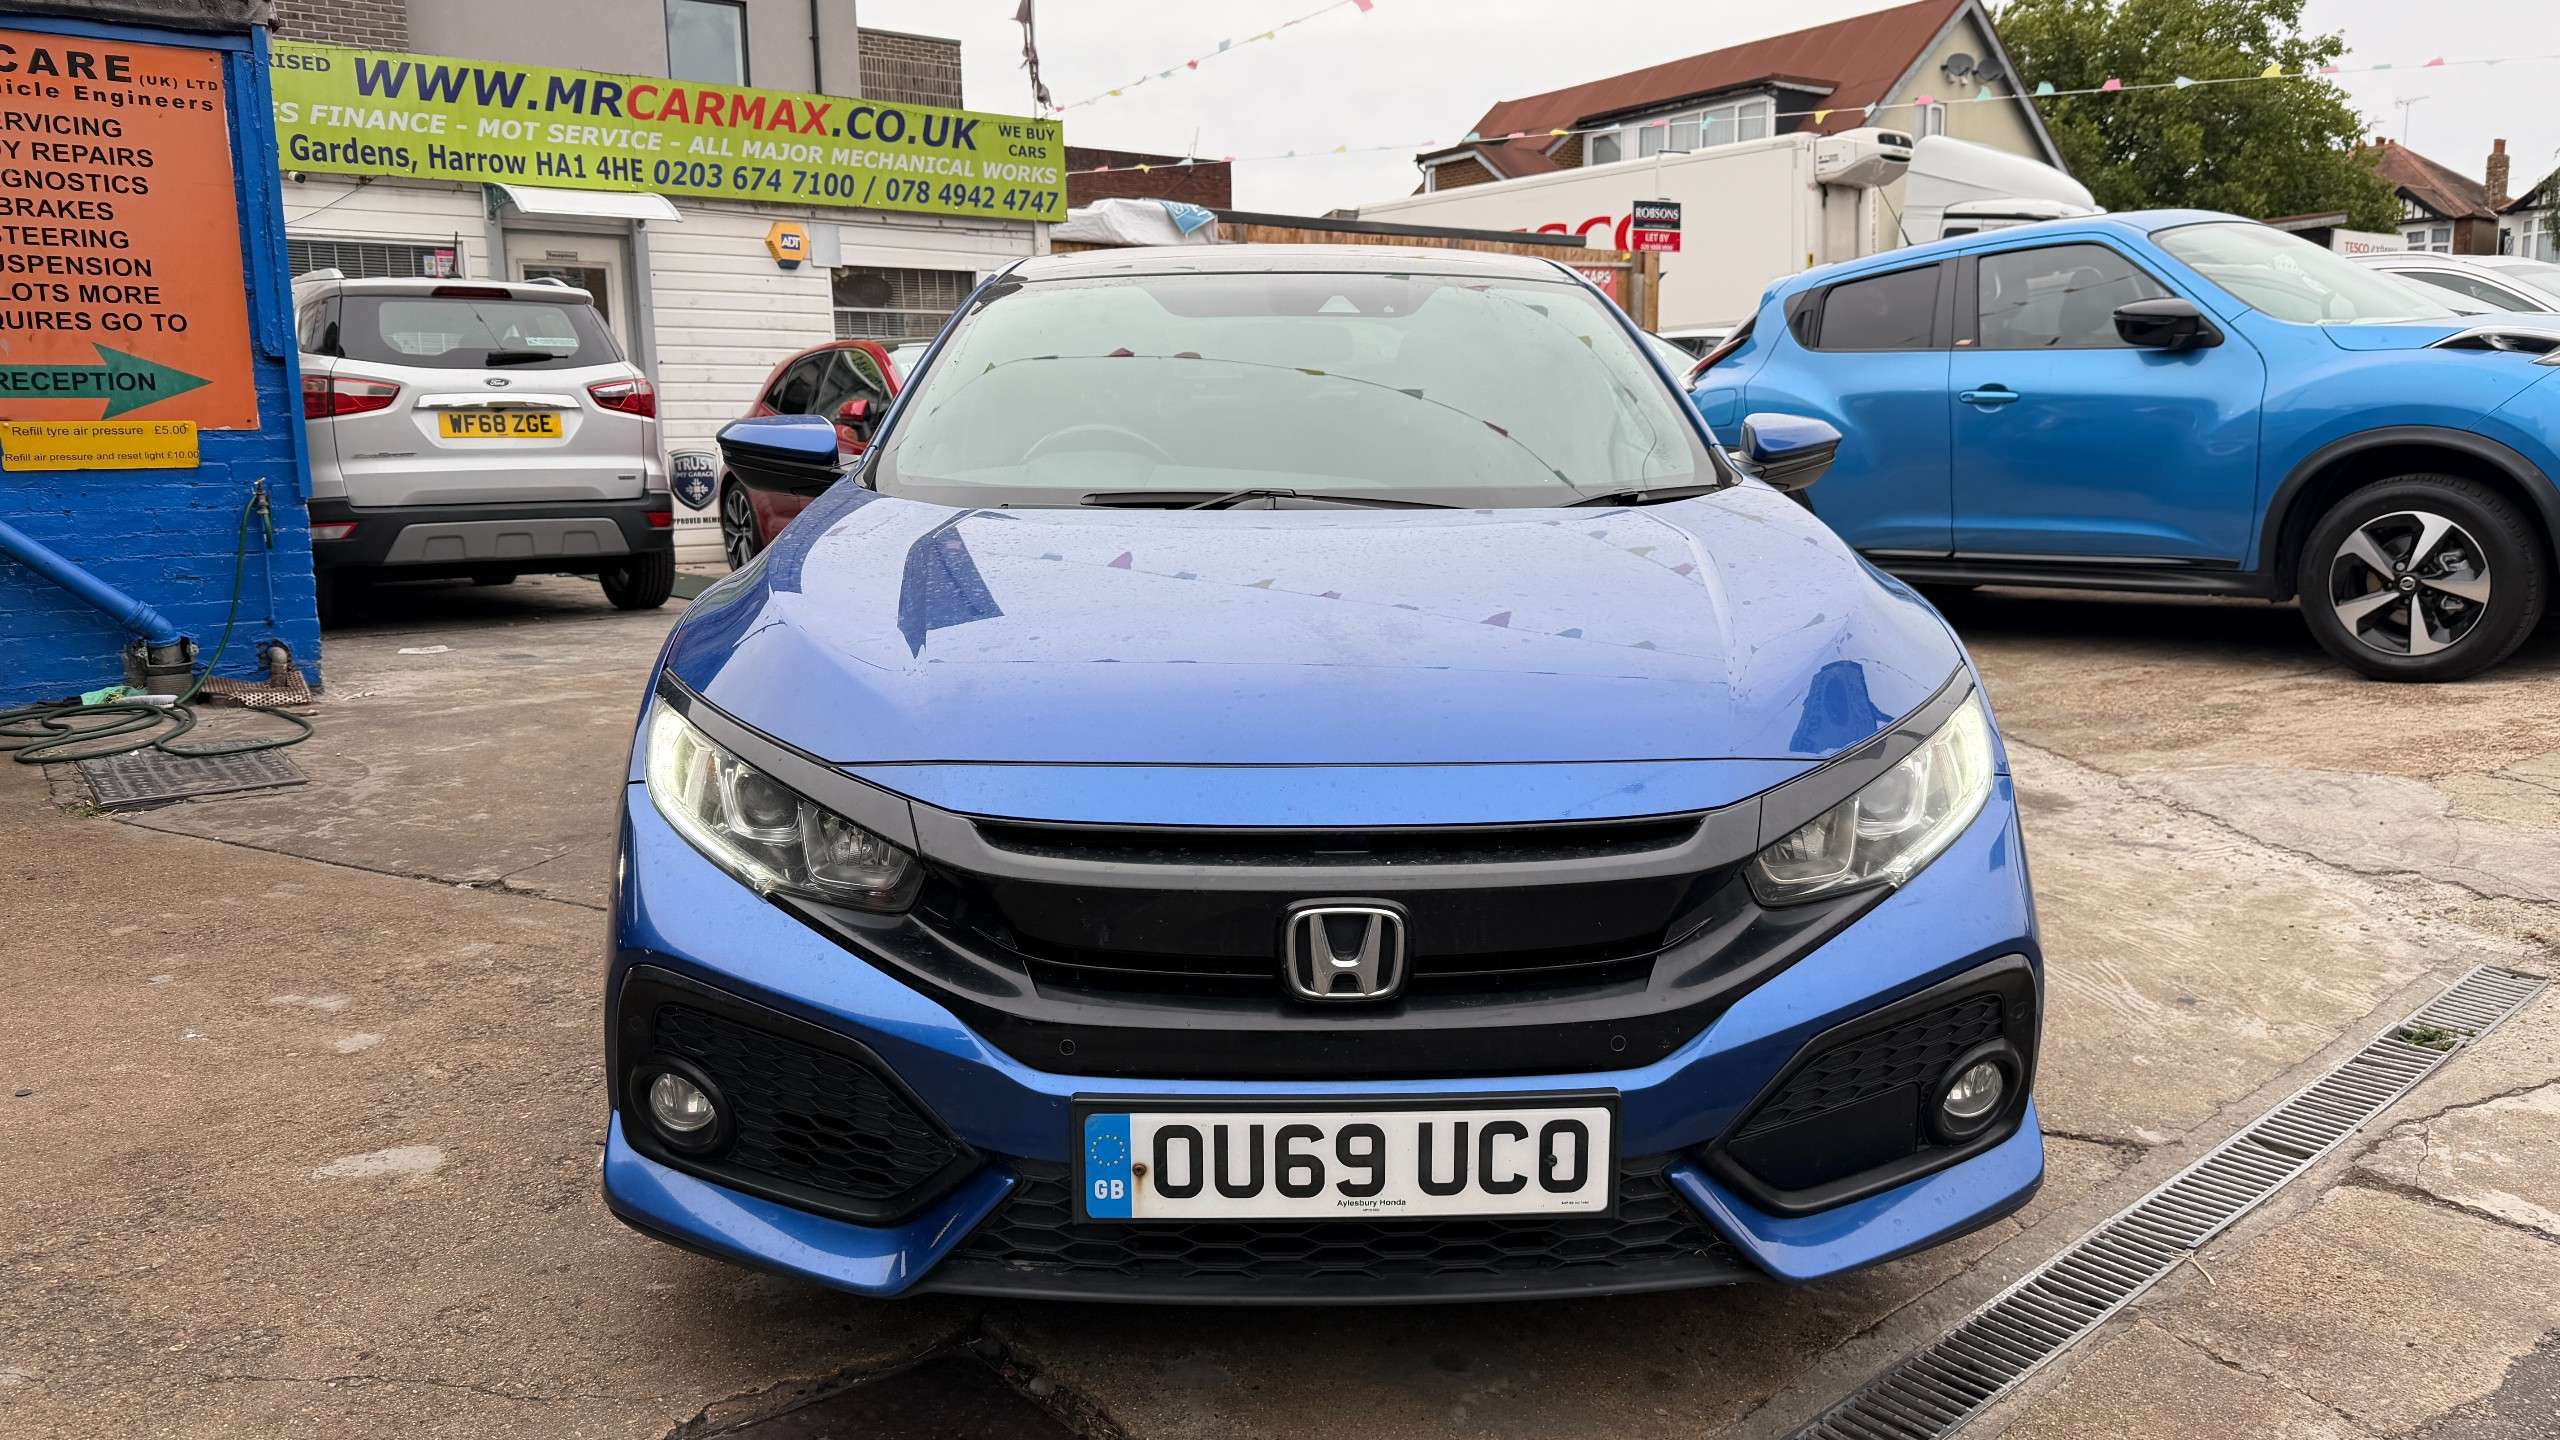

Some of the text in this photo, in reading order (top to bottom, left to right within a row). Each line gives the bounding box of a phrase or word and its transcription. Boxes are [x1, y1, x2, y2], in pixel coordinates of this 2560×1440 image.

[0, 43, 218, 91] CARE (UK) LTD
[0, 79, 214, 112] icle Engineers
[354, 57, 981, 151] WWW.MRCARMAX.CO.UK
[0, 111, 122, 138] RVICING
[998, 125, 1055, 142] WE BUY
[31, 142, 154, 168] REPAIRS
[309, 104, 447, 135] FINANCE
[477, 117, 541, 141] MOT
[547, 123, 663, 151] SERVICE
[688, 135, 734, 158] ALL
[741, 139, 824, 165] MAJOR
[831, 147, 976, 178] MECHANICAL
[982, 161, 1058, 185] WORKS
[1008, 144, 1047, 160] CARS
[290, 133, 418, 174] Gardens,
[428, 143, 526, 176] Harrow
[536, 151, 587, 179] HA1
[596, 156, 644, 184] 4HE
[653, 159, 723, 189] 0203
[732, 165, 782, 193] 674
[792, 170, 855, 198] 7100
[886, 178, 931, 204] 078
[938, 183, 996, 209] 4942
[1002, 188, 1059, 213] 4747
[0, 197, 114, 221] BRAKES
[1635, 207, 1679, 219] ROBSONS
[0, 225, 129, 249] TEERING
[781, 235, 800, 248] ADT
[1645, 232, 1659, 242] LET
[0, 254, 152, 277] SPENSION
[79, 284, 161, 304] MORE
[101, 312, 143, 331] GO
[150, 313, 187, 332] TO
[12, 425, 187, 438] Refill tyre air pressure £5.00
[449, 414, 553, 433] WF68 ZGE
[5, 454, 31, 462] Refill
[34, 453, 47, 461] air
[49, 453, 93, 464] pressure
[96, 451, 115, 460] and
[117, 450, 141, 460] reset
[144, 450, 164, 463] light
[675, 456, 713, 471] TRUST
[1152, 1118, 1589, 1199] OU69 UCO
[1094, 1179, 1125, 1200] GB
